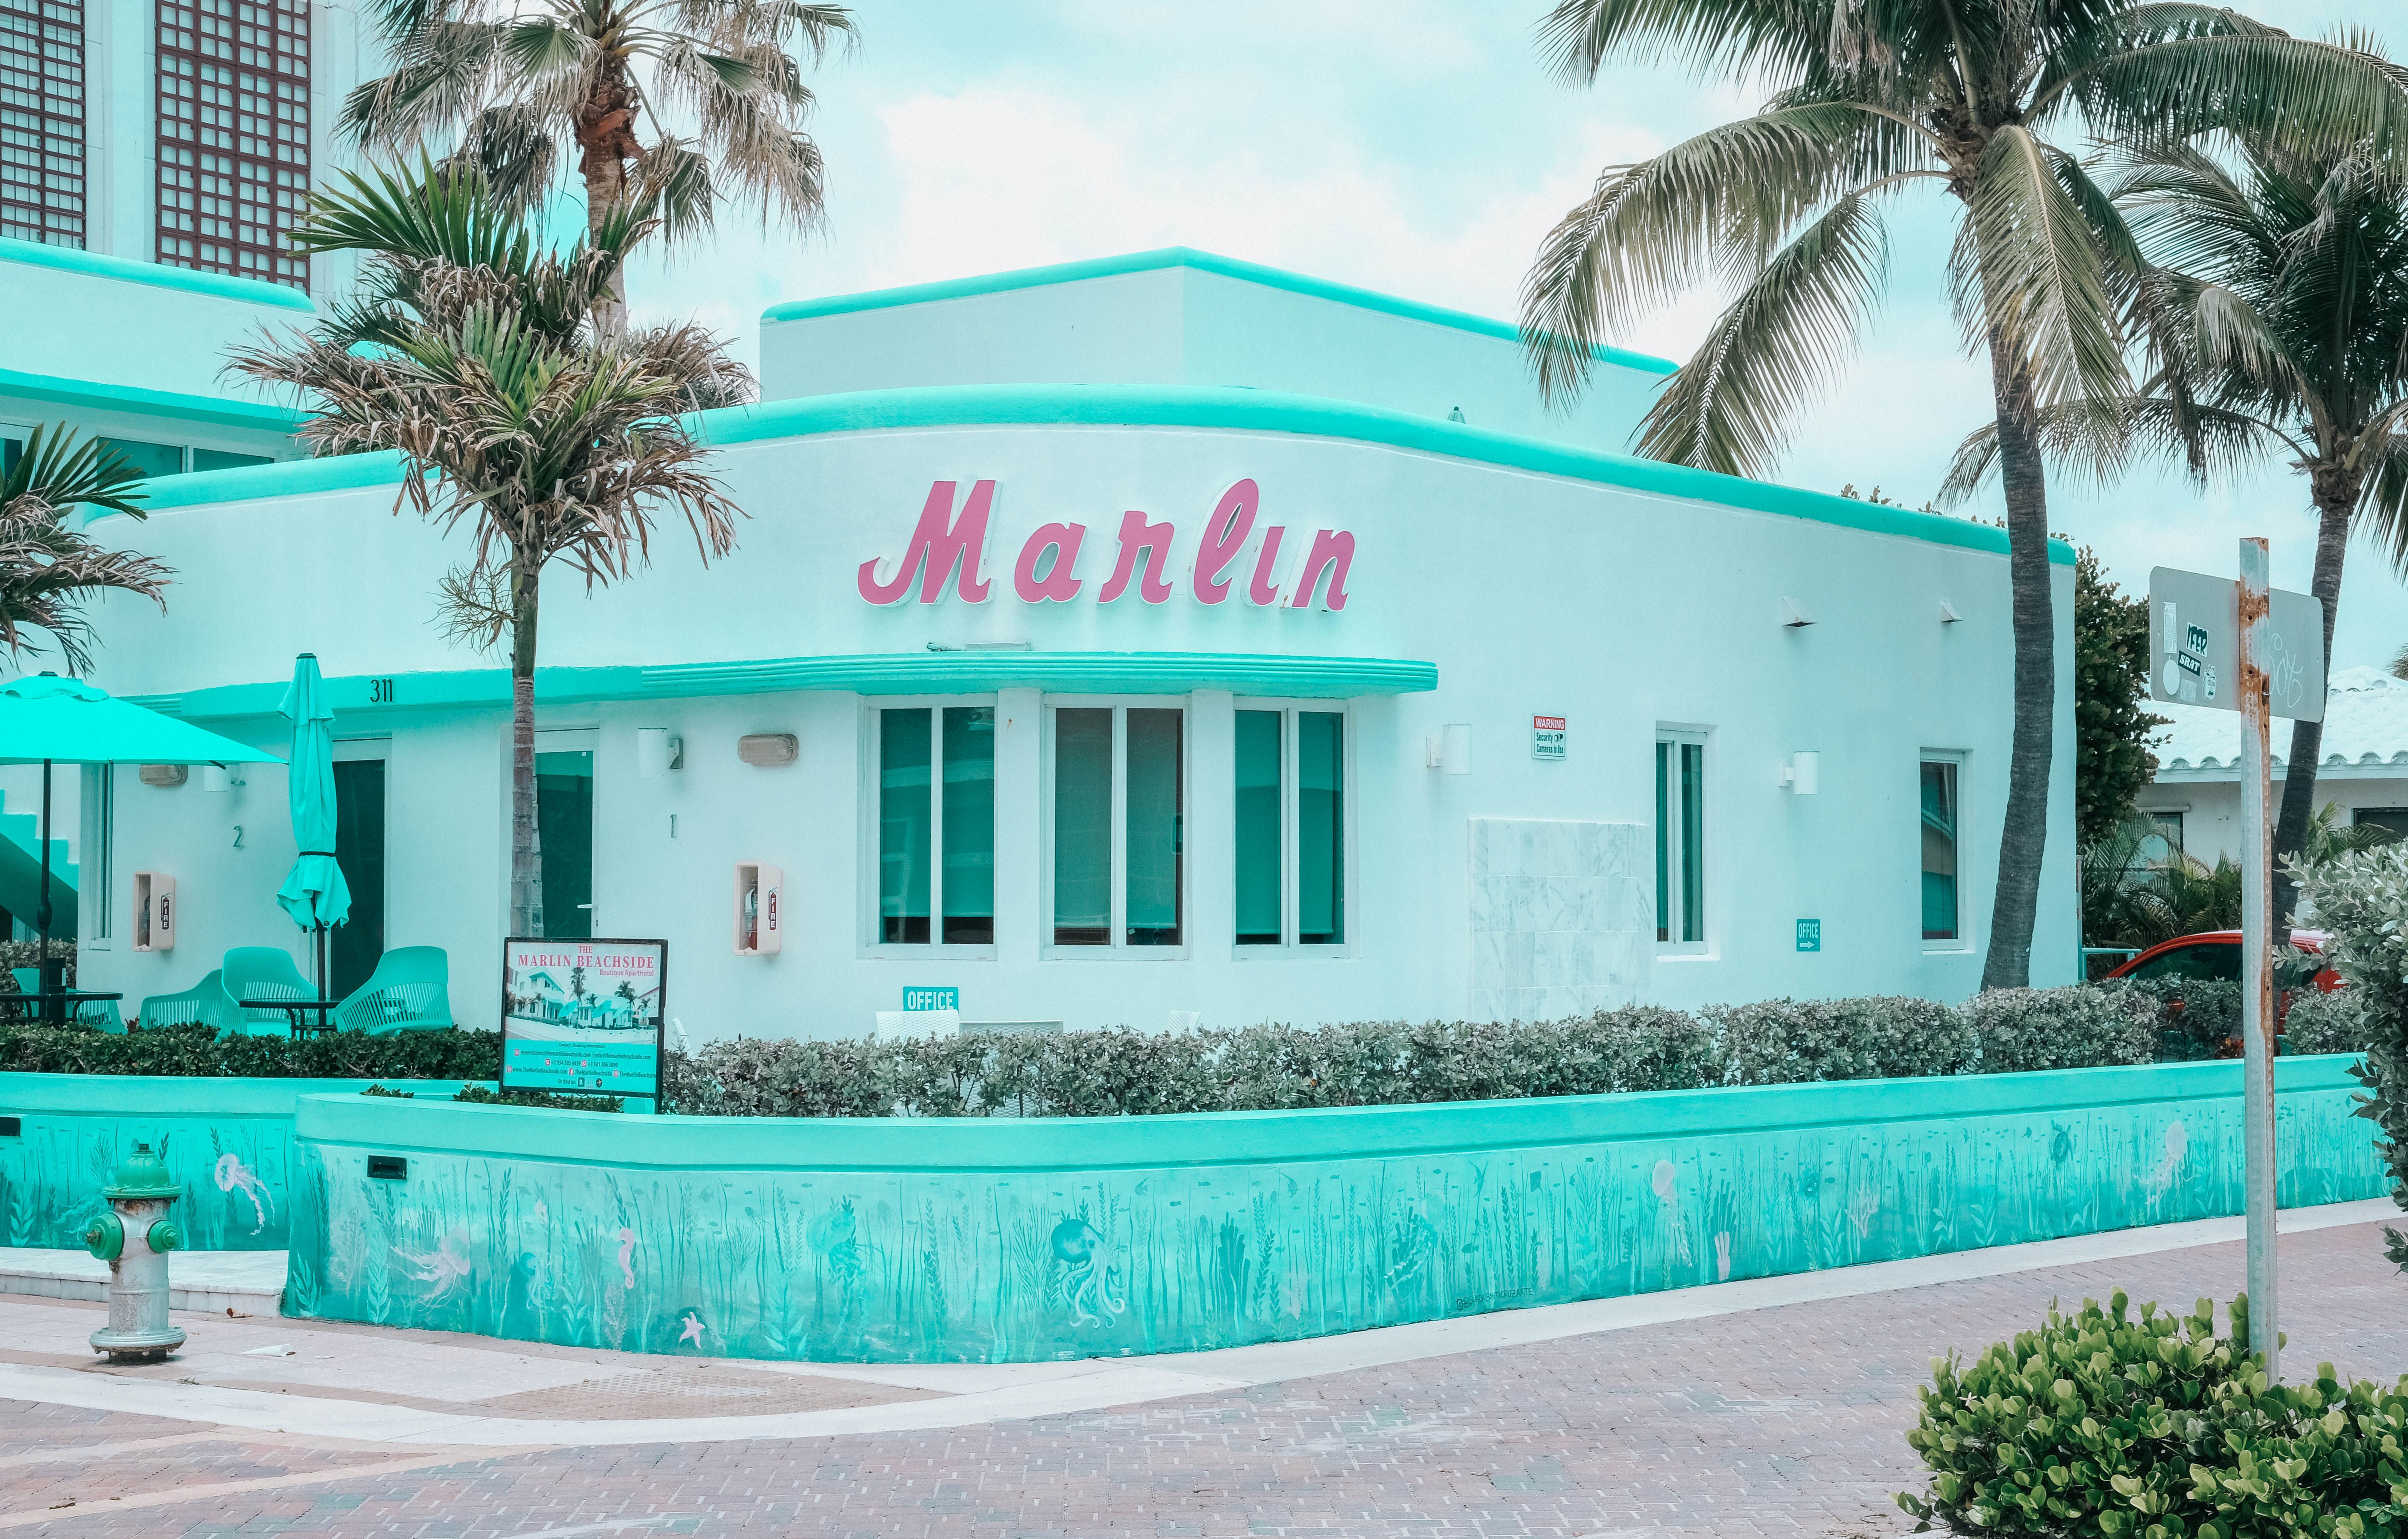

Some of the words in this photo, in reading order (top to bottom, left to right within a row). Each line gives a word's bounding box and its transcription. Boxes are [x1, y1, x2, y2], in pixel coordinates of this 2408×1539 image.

[858, 478, 1355, 611] Marlin
[2179, 654, 2200, 672] SRAT
[370, 679, 393, 702] 311
[1535, 718, 1564, 729] WARNING
[1536, 732, 1553, 743] Security
[1537, 743, 1552, 753] Cameras
[670, 814, 677, 838] 1
[233, 825, 244, 847] 2
[1798, 922, 1819, 938] OFFICE
[518, 954, 572, 967] MARLIN
[576, 955, 654, 968] BEACHSIDE
[908, 991, 954, 1010] OFFICE
